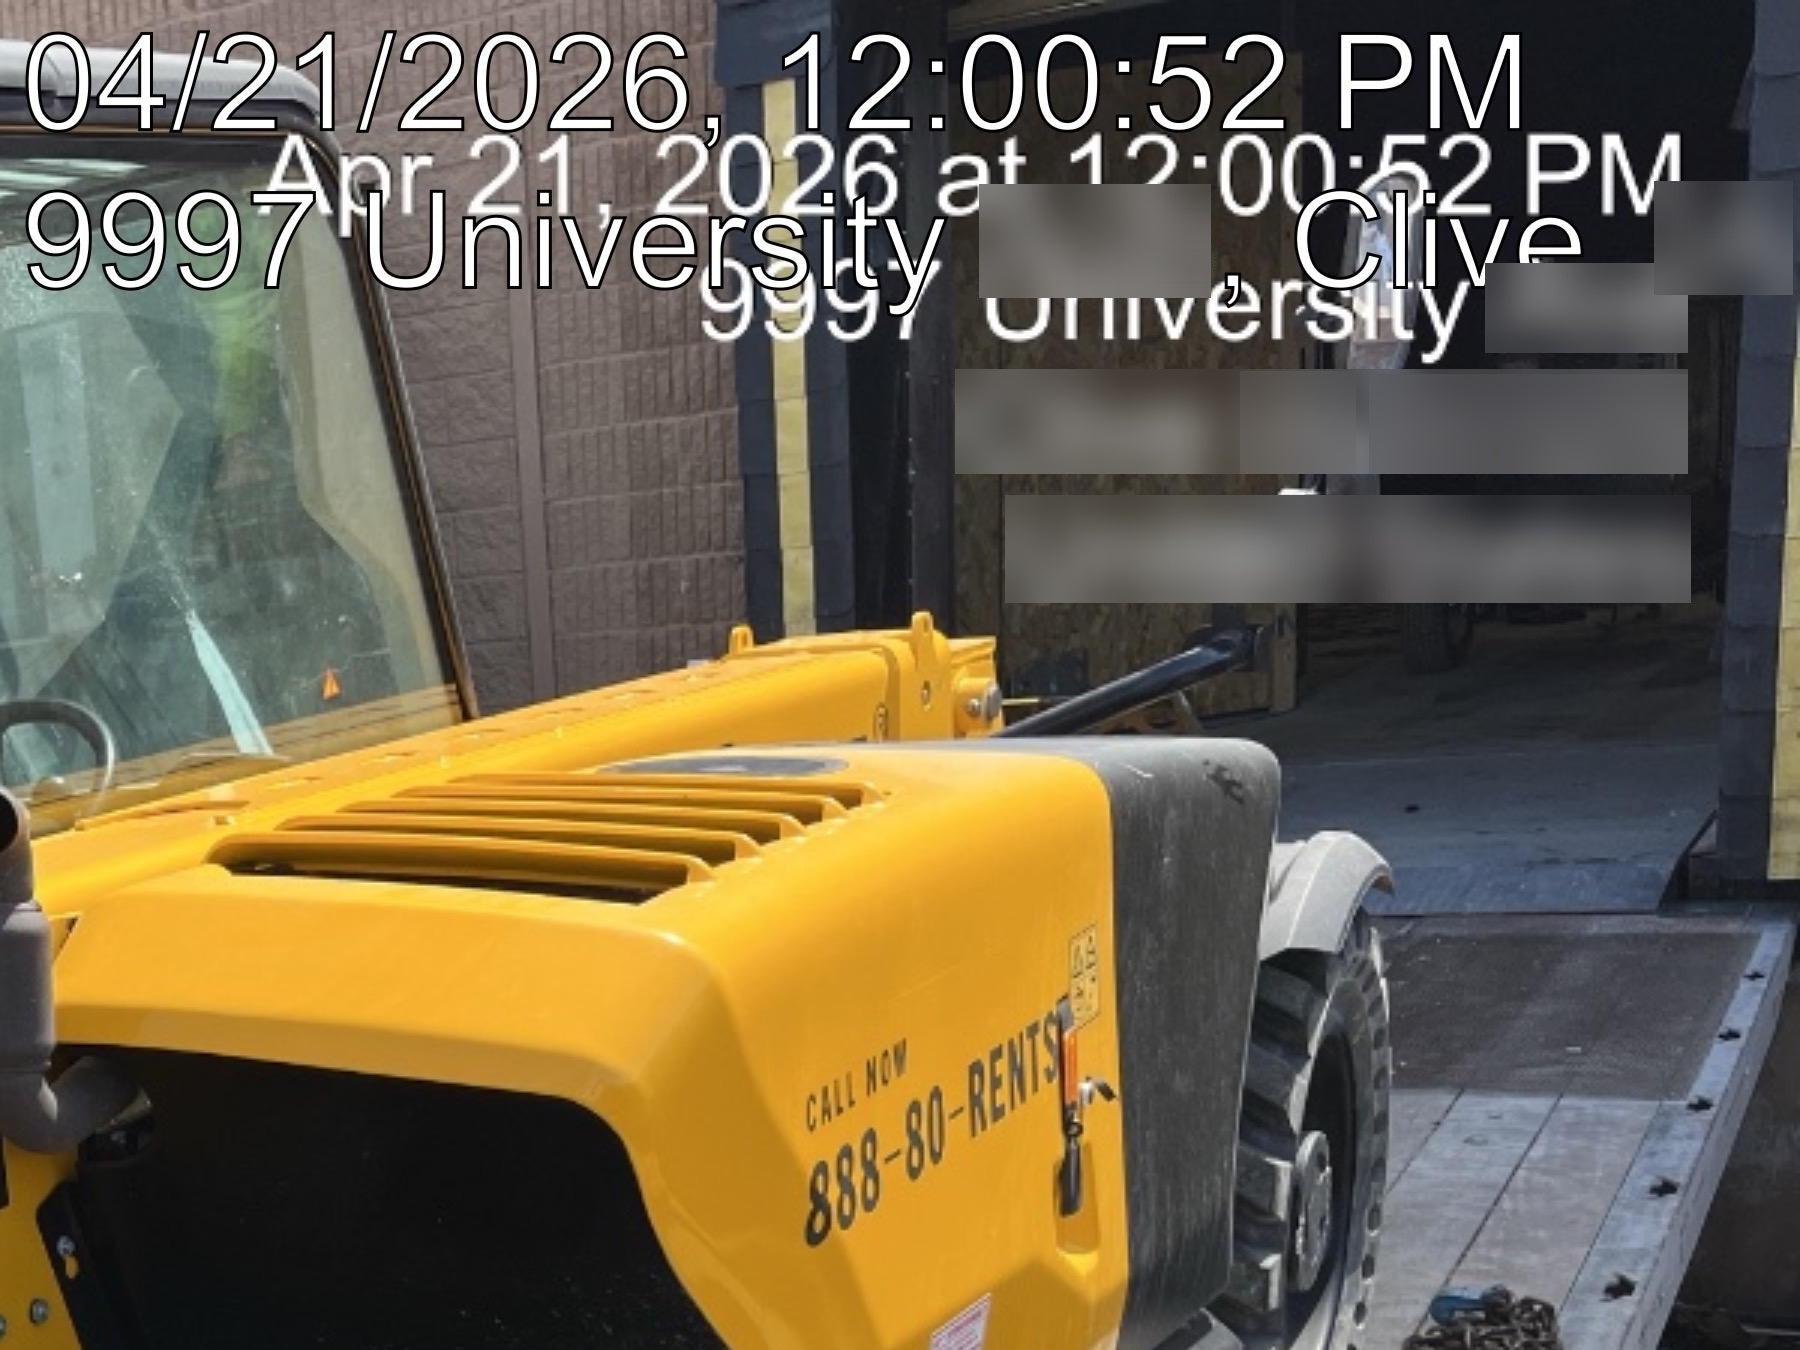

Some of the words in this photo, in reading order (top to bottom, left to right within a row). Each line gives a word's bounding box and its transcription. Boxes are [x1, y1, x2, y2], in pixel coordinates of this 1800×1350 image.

[804, 1008, 1060, 1249] 888-80-RENTS
[806, 1072, 855, 1133] CALL
[867, 1037, 908, 1098] NOW
